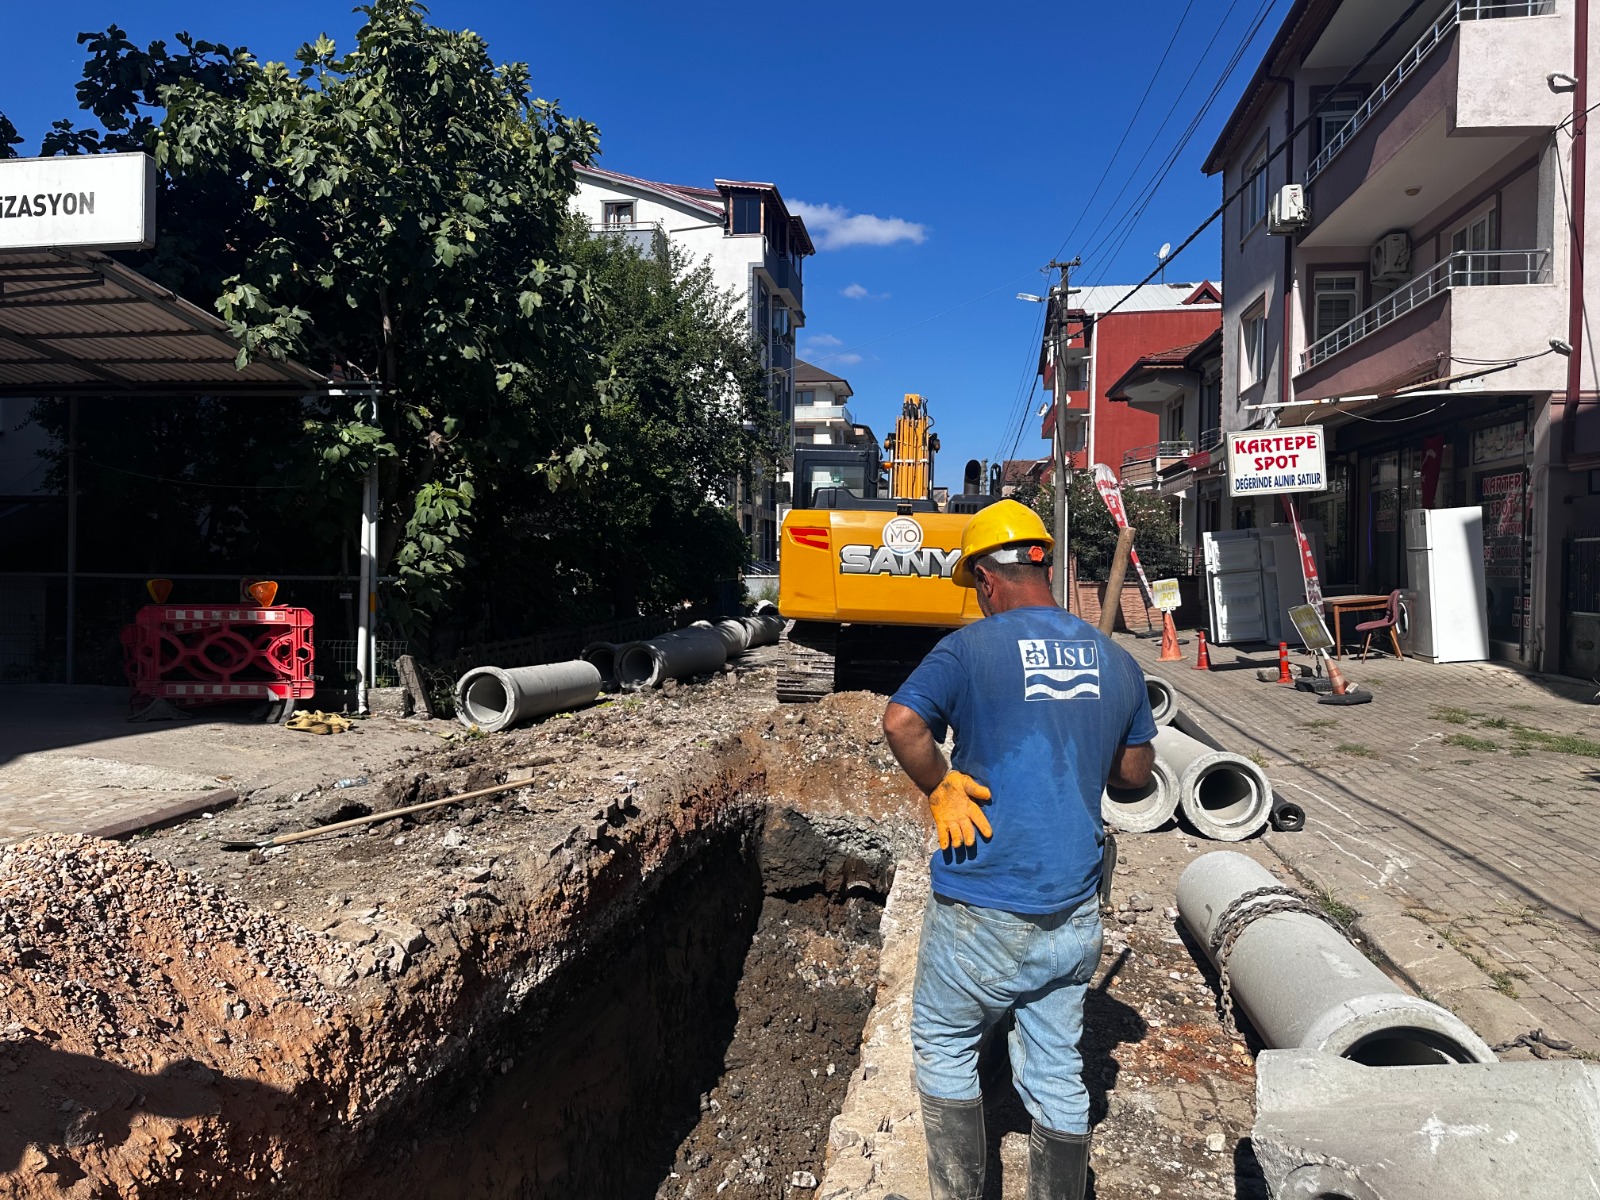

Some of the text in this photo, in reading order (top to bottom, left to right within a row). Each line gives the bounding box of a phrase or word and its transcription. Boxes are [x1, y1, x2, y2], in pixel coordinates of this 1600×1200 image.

[1235, 435, 1317, 454] KARTEPE
[1254, 454, 1299, 471] SPOT
[1235, 472, 1321, 490] DEĞERİNDE ALINIR SATILIR
[1483, 472, 1524, 496] KARTEP
[1490, 498, 1514, 518] SPOT
[840, 545, 962, 577] SANY
